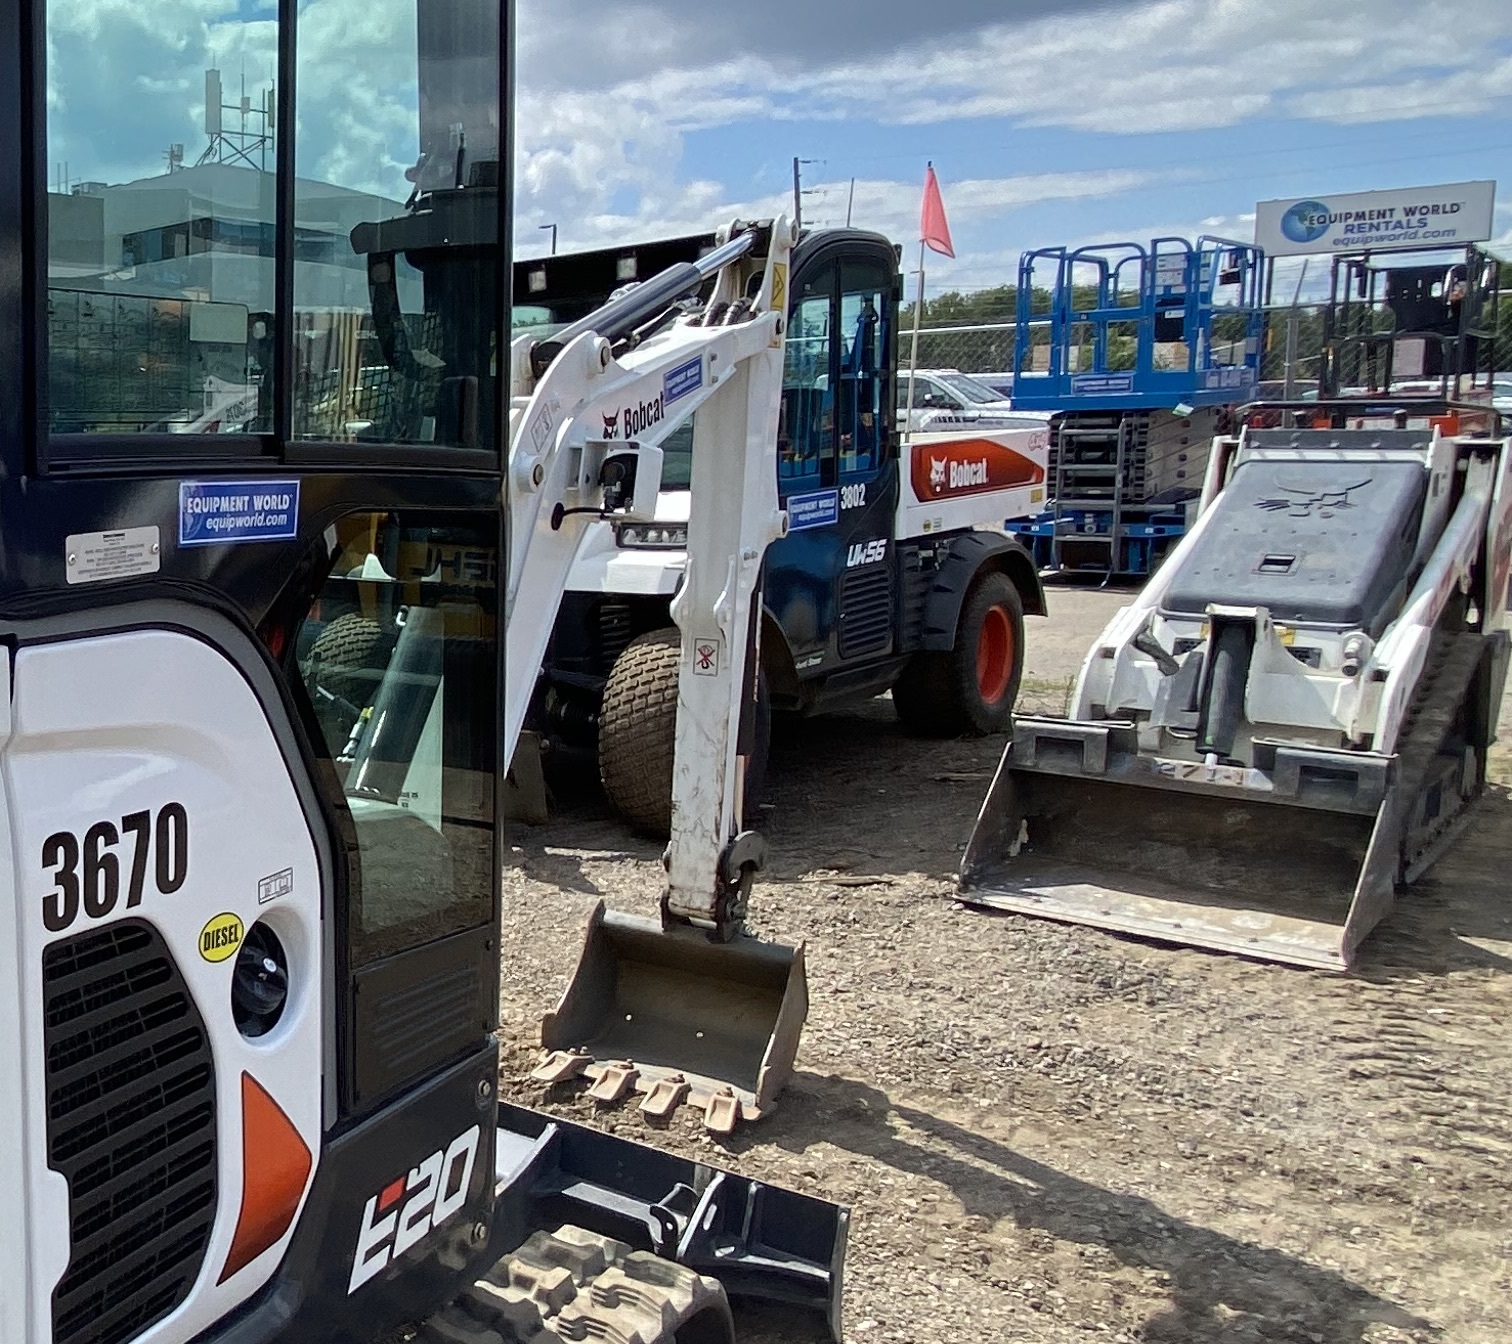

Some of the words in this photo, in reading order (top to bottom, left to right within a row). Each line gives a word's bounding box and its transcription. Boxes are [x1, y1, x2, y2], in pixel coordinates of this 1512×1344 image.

[1308, 207, 1395, 226] EQUIPMENT
[1343, 217, 1428, 235] RENTALS
[1332, 228, 1456, 247] equipworld.com
[624, 391, 664, 440] Bobcat
[949, 458, 987, 488] Bobcat
[187, 496, 250, 513] EQUIPMENT
[840, 483, 866, 510] 3802
[206, 512, 287, 533] equipworld.com
[847, 539, 887, 567] UW56
[42, 802, 187, 932] 3670
[203, 923, 239, 952] DIESEL
[348, 1124, 480, 1295] E20
